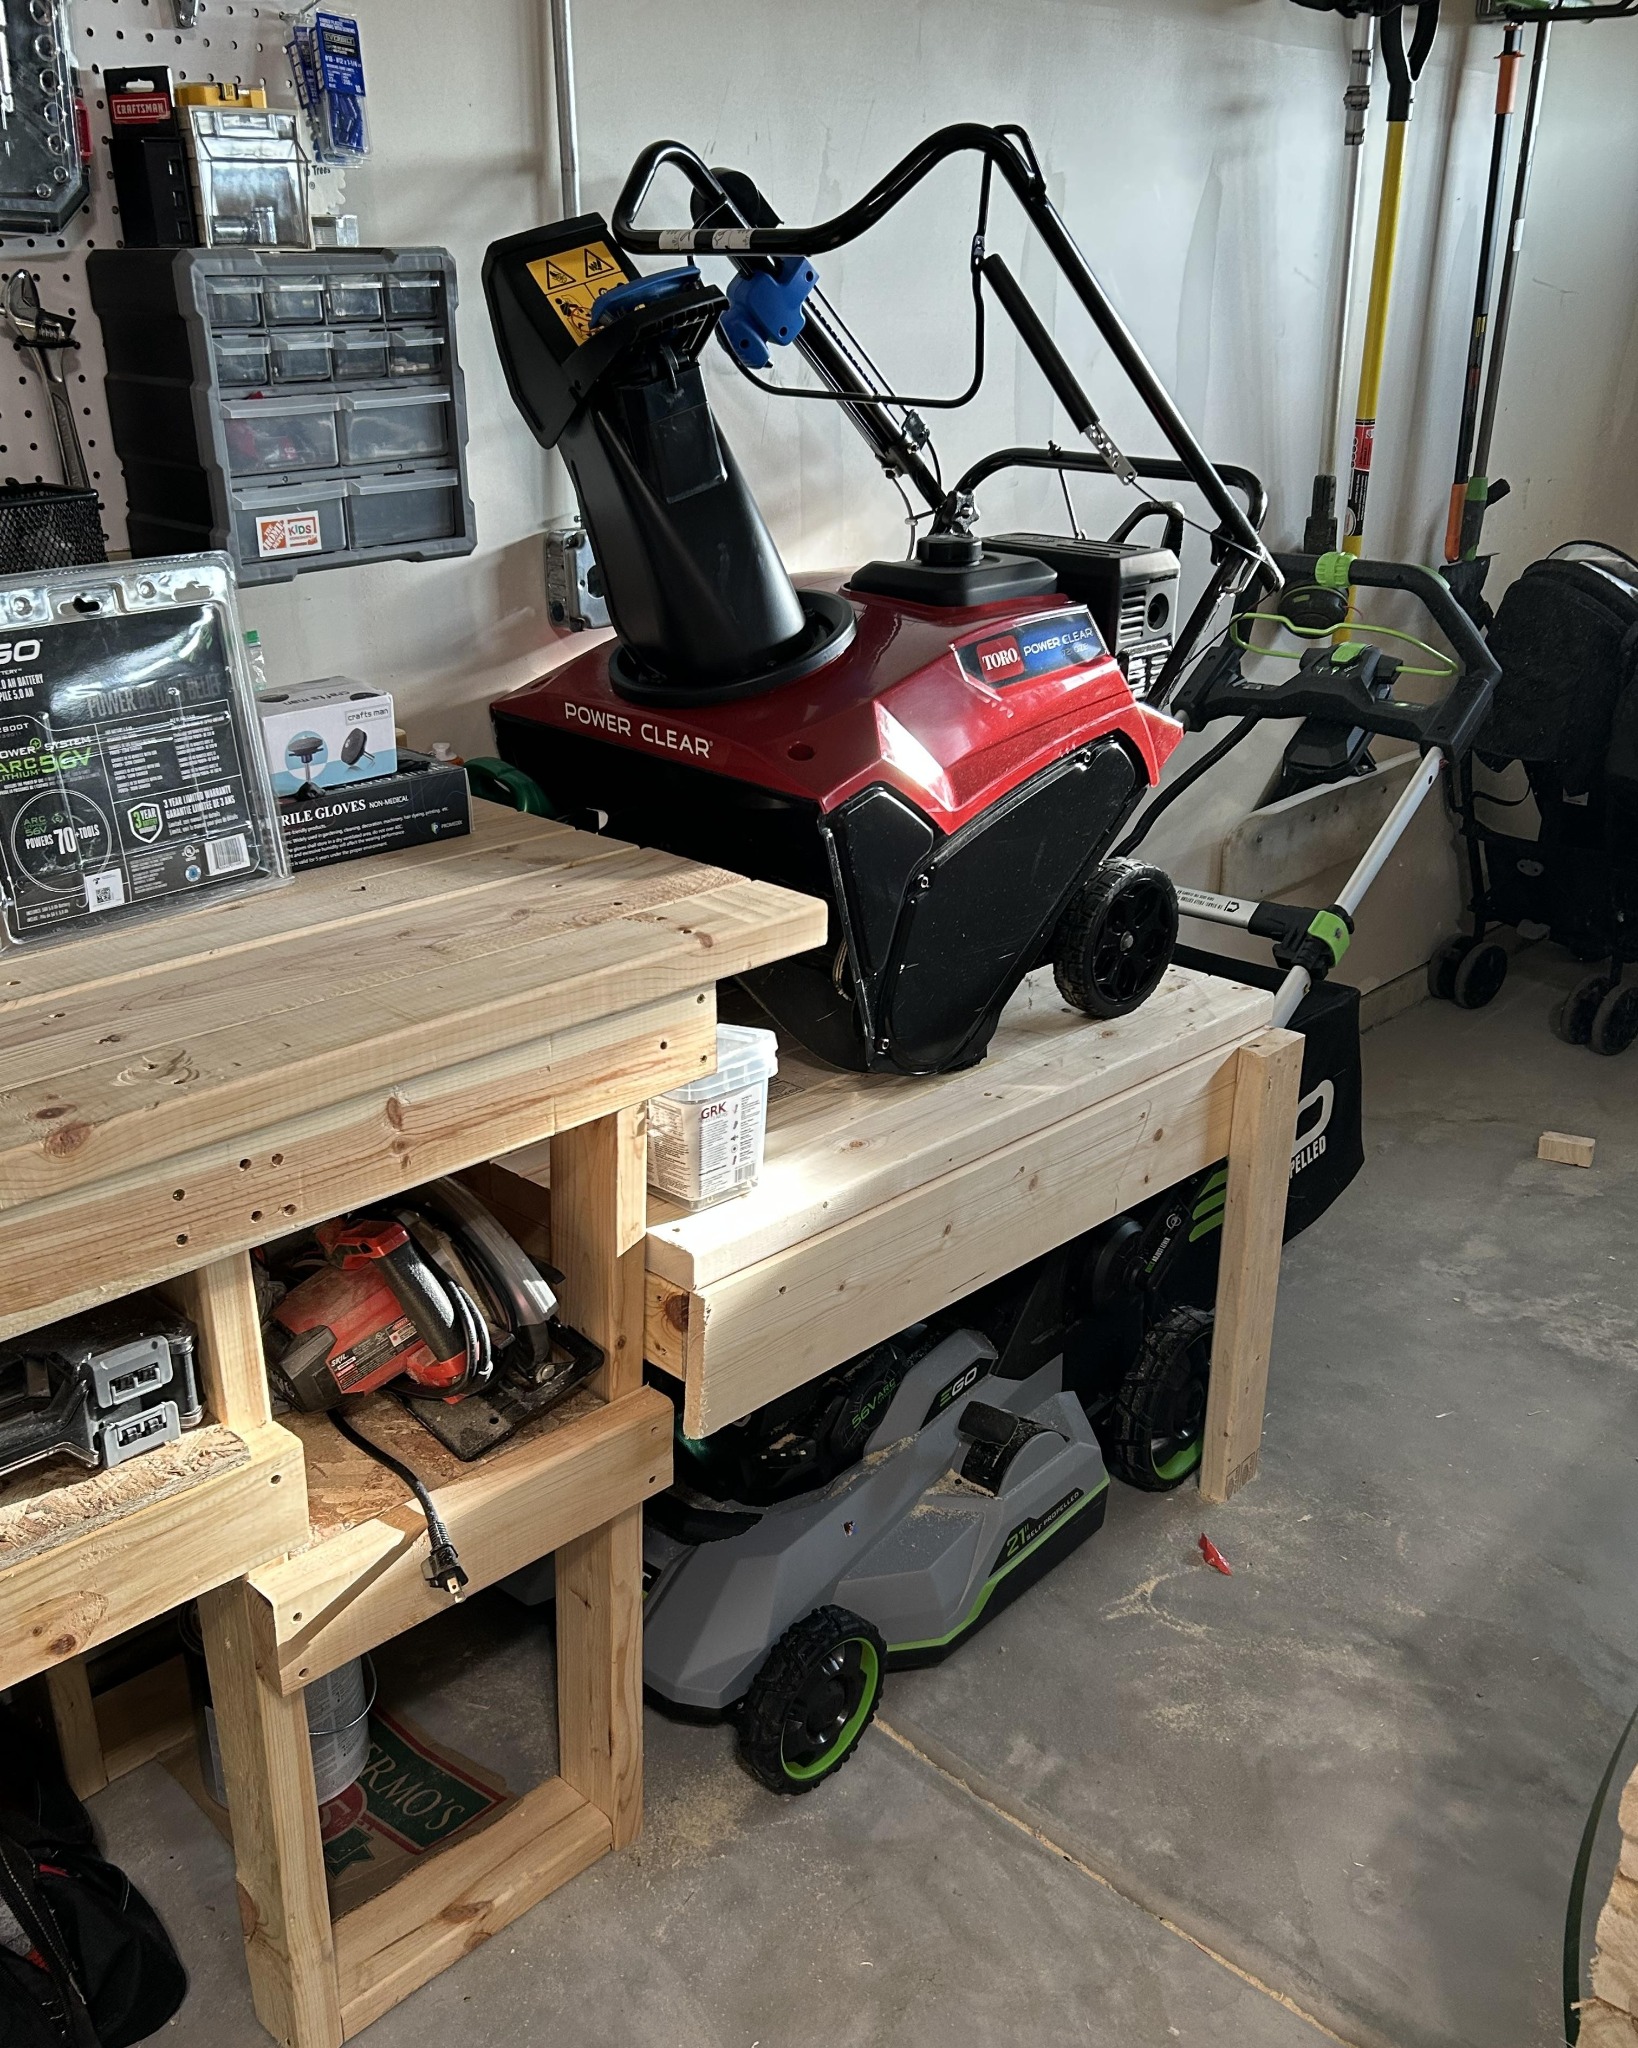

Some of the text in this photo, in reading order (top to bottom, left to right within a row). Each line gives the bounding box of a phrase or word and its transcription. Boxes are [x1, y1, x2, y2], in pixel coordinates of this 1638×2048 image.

[116, 102, 165, 115] CRAFTSMAN
[312, 165, 331, 176] Trees
[288, 525, 312, 536] KIDS
[1023, 627, 1093, 657] POWER CLEAR
[982, 647, 1018, 671] TORO
[347, 708, 389, 721] crafts man
[565, 702, 631, 737] POWER
[40, 747, 91, 773] 56V
[162, 799, 168, 808] 3
[168, 796, 183, 807] YEAR
[224, 794, 235, 805] ANS
[132, 807, 156, 829] 3 YEAR
[282, 795, 409, 827] RILE GLOVES NON-MEDICAL
[24, 815, 46, 825] ARC
[25, 826, 47, 837] 56V
[25, 834, 54, 849] POWERS
[701, 1101, 727, 1120] GRK
[331, 1354, 349, 1368] SKIL
[940, 1366, 978, 1408] EGO
[851, 1395, 878, 1429] 56V
[1026, 1523, 1043, 1541] SELF
[1043, 1491, 1080, 1525] PROPELLED
